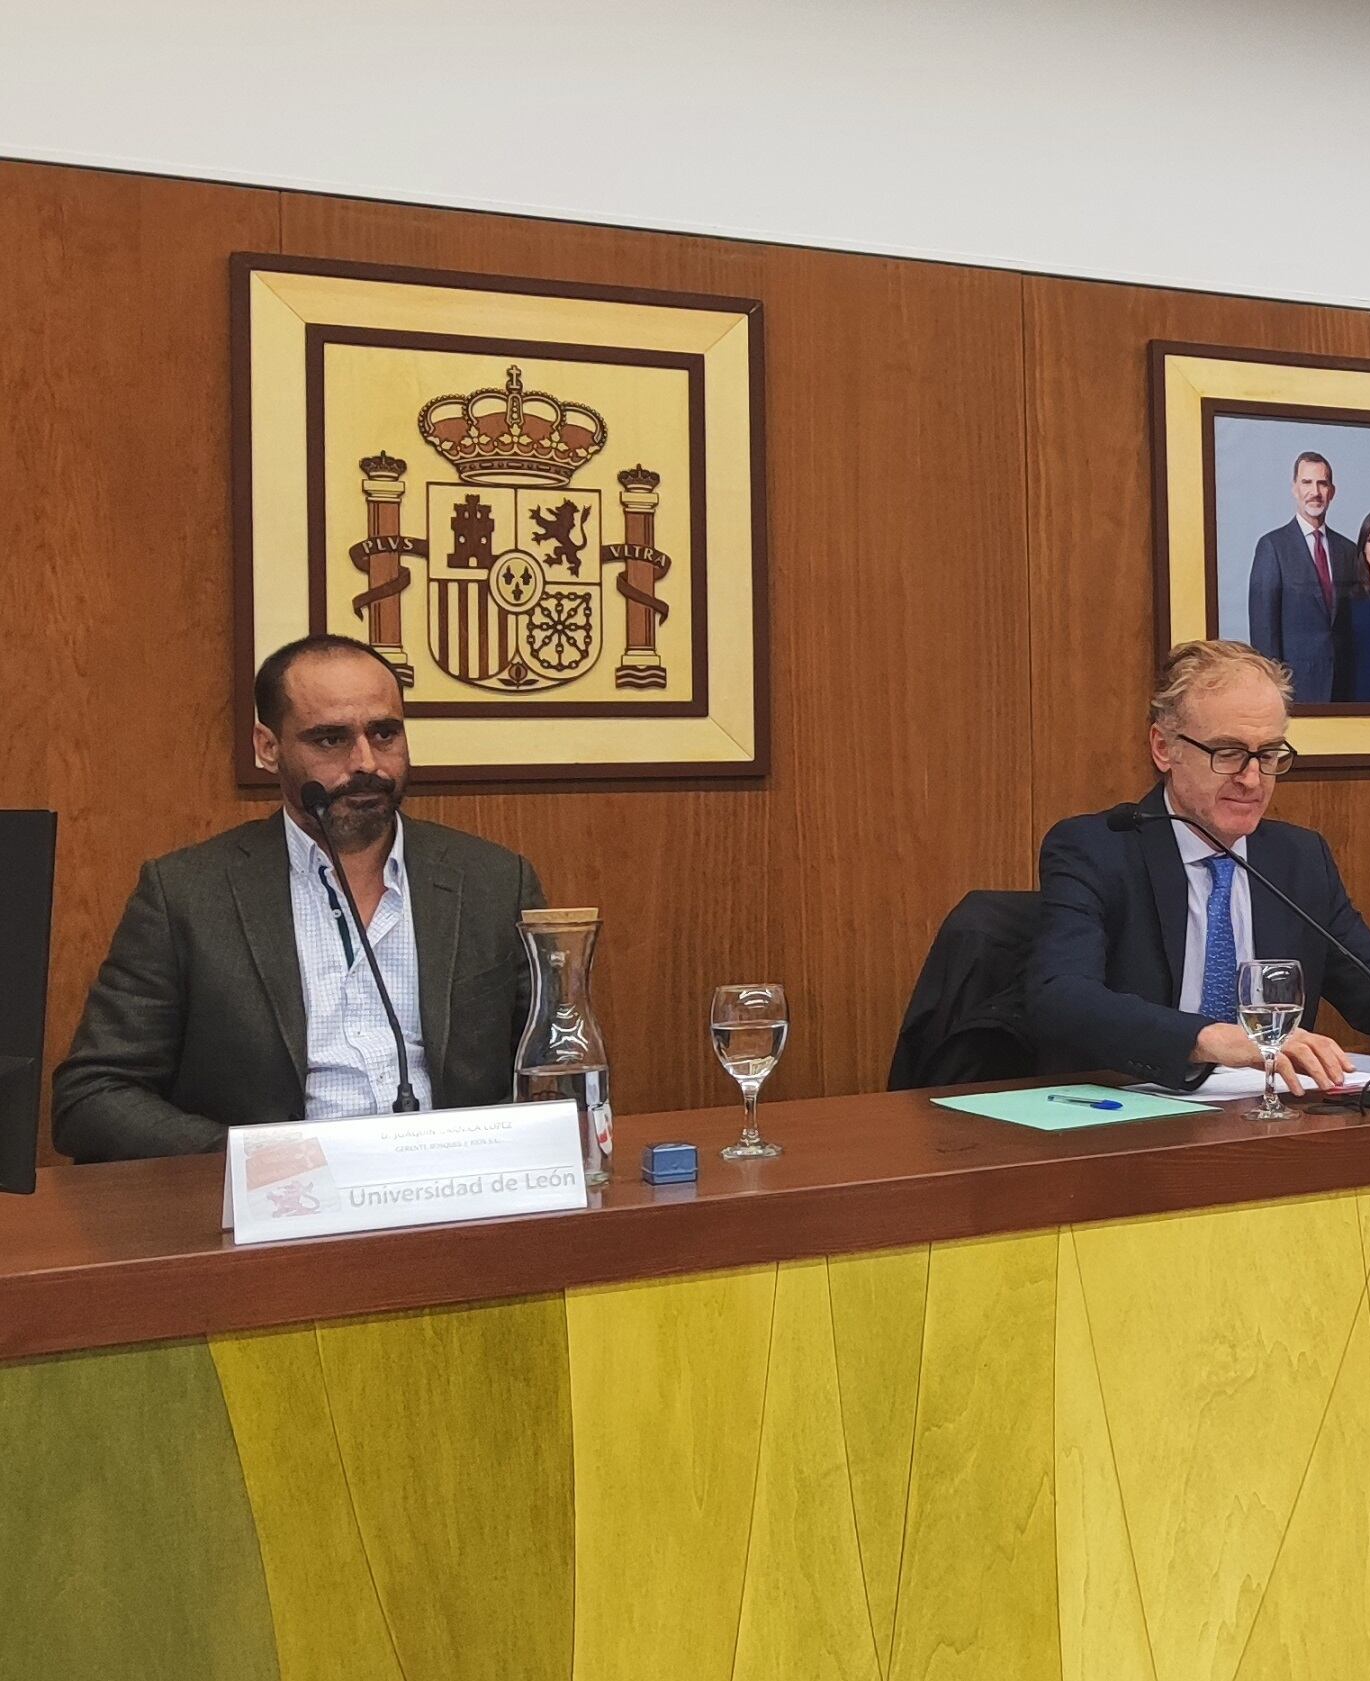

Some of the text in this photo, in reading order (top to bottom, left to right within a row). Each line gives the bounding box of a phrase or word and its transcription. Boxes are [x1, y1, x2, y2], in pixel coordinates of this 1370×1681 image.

[362, 538, 415, 554] PLVS
[608, 544, 668, 568] VLTRA
[350, 1168, 576, 1207] Universidad de León
